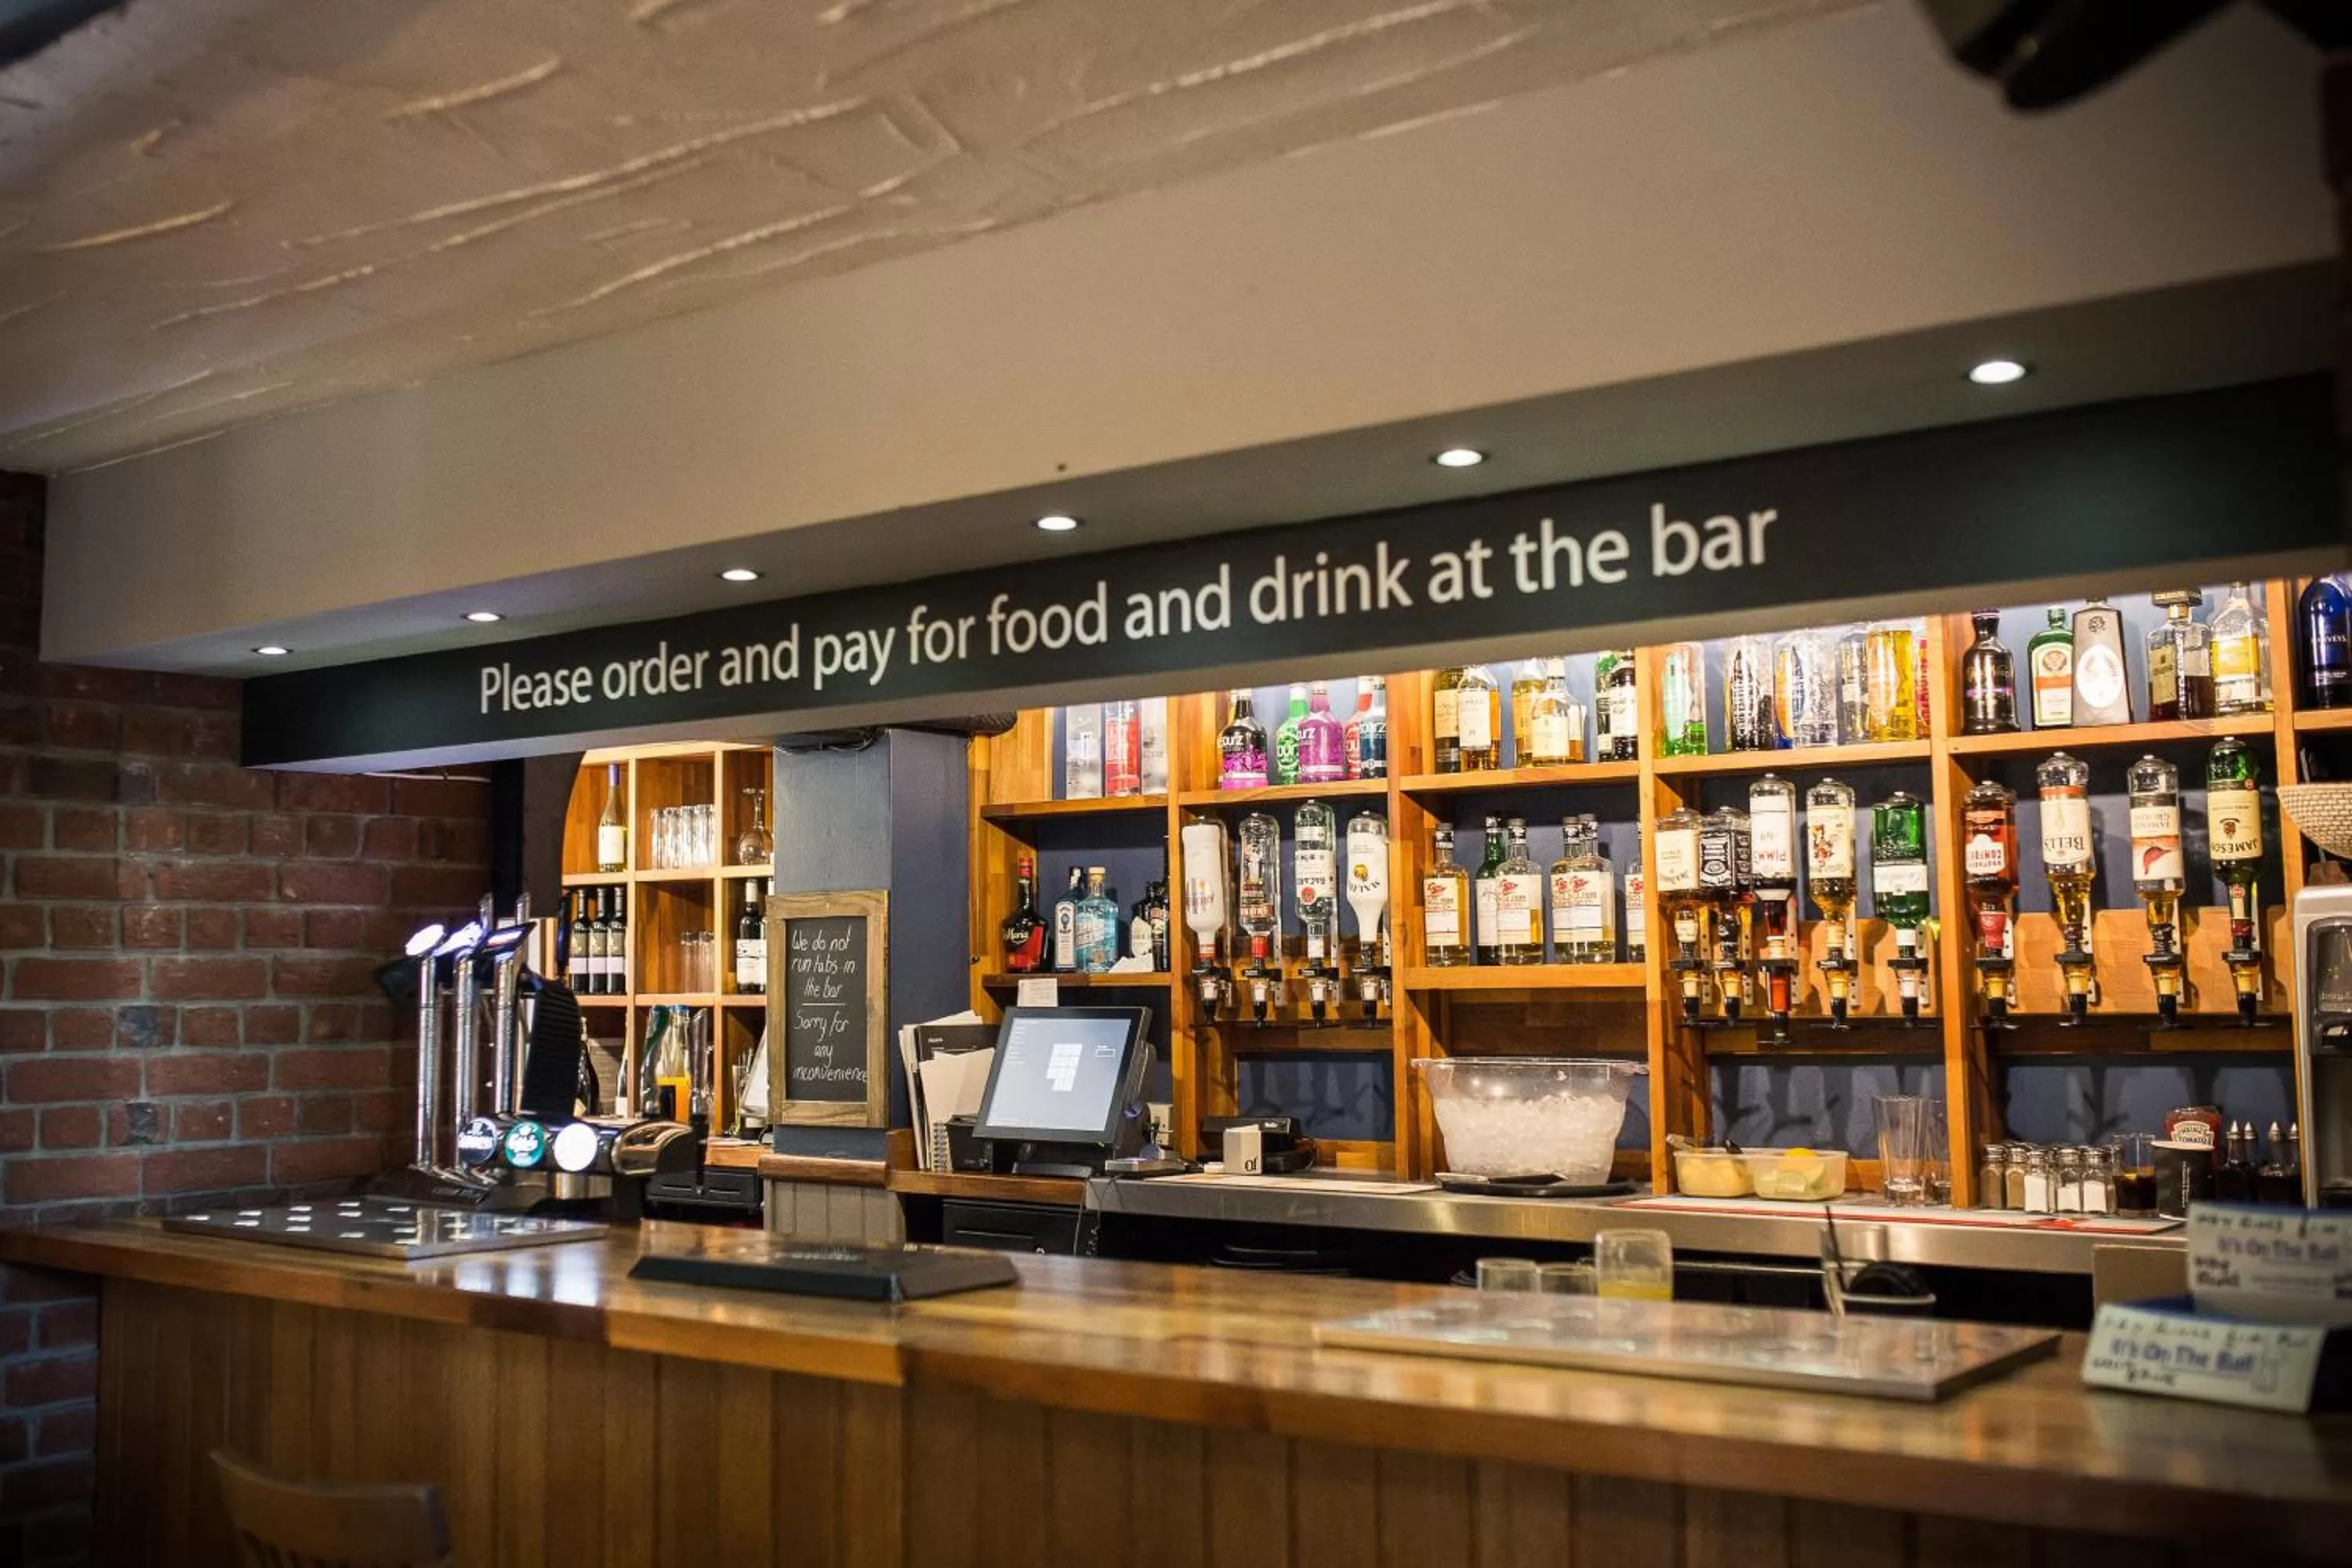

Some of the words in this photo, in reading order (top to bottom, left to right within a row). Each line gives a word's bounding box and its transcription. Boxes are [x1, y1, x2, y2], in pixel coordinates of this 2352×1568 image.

[481, 662, 593, 714] Please
[602, 641, 710, 700] order
[720, 624, 799, 686] and
[814, 626, 896, 691] pay
[906, 605, 975, 665] for
[987, 581, 1108, 655] food
[1124, 563, 1232, 640] and
[1249, 542, 1413, 624] drink
[1428, 539, 1494, 604] at
[1508, 518, 1630, 593] the
[1651, 503, 1777, 577] bar
[2044, 836, 2085, 852] BELL'S
[791, 929, 809, 951] We
[811, 929, 826, 950] do
[829, 925, 852, 950] not
[791, 958, 812, 973] run
[814, 954, 838, 975] tabs
[843, 957, 856, 974] in
[804, 978, 821, 997] the
[822, 978, 844, 998] bar
[793, 1010, 828, 1042] Sorry
[829, 1011, 850, 1037] for
[814, 1044, 834, 1066] any
